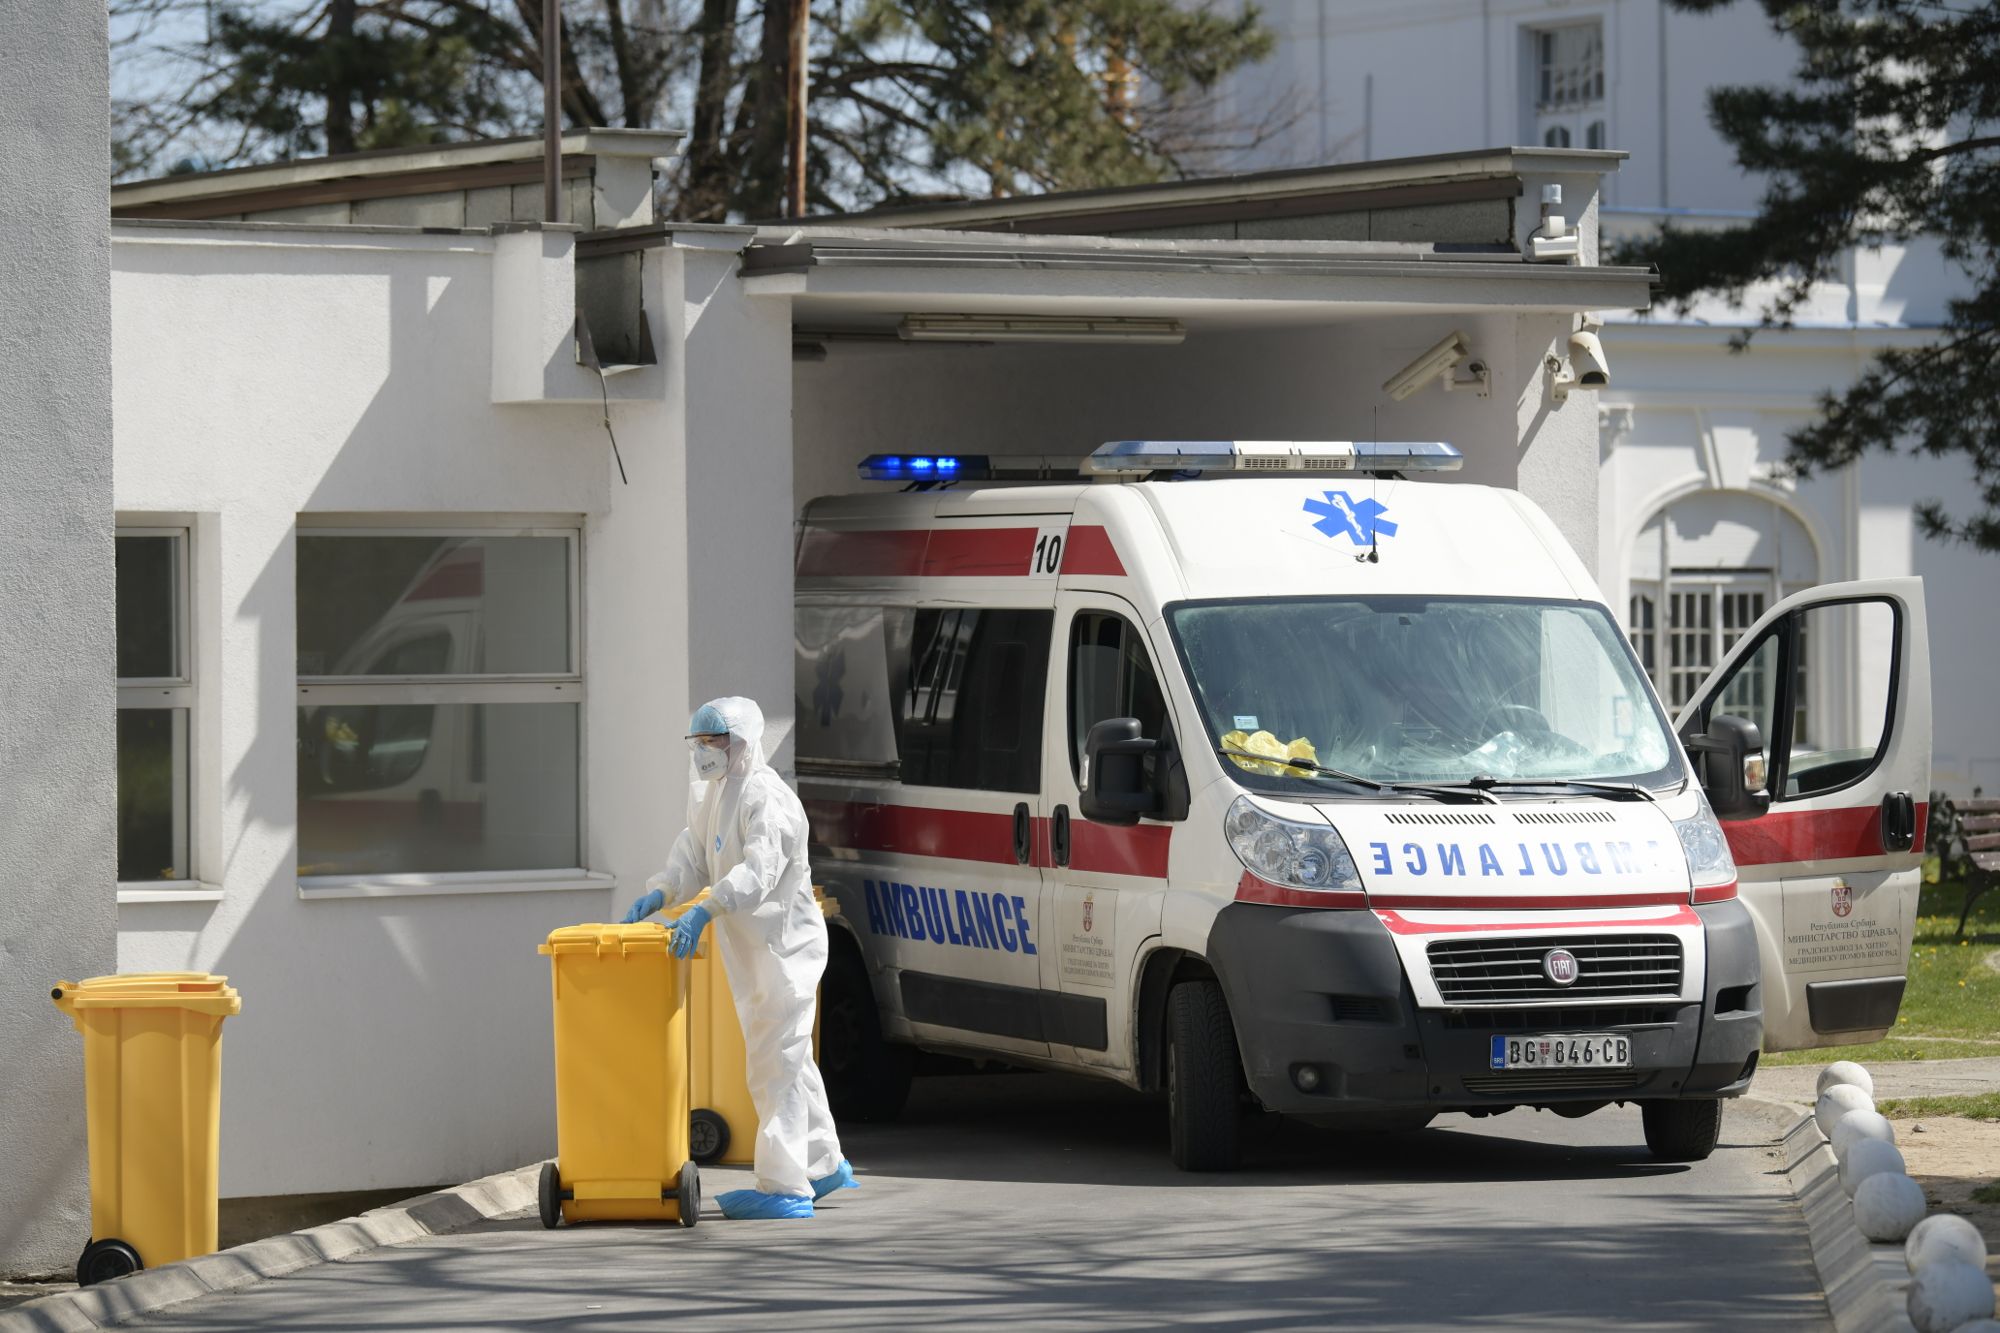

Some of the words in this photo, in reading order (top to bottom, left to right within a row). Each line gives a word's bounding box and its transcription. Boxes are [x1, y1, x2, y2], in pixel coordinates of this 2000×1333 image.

[1036, 535, 1062, 574] 10
[863, 879, 1038, 955] AMBULANCE
[1787, 931, 1859, 944] МИНИСТАРСТВО
[1552, 960, 1571, 976] FIAT
[1510, 1041, 1536, 1064] BG
